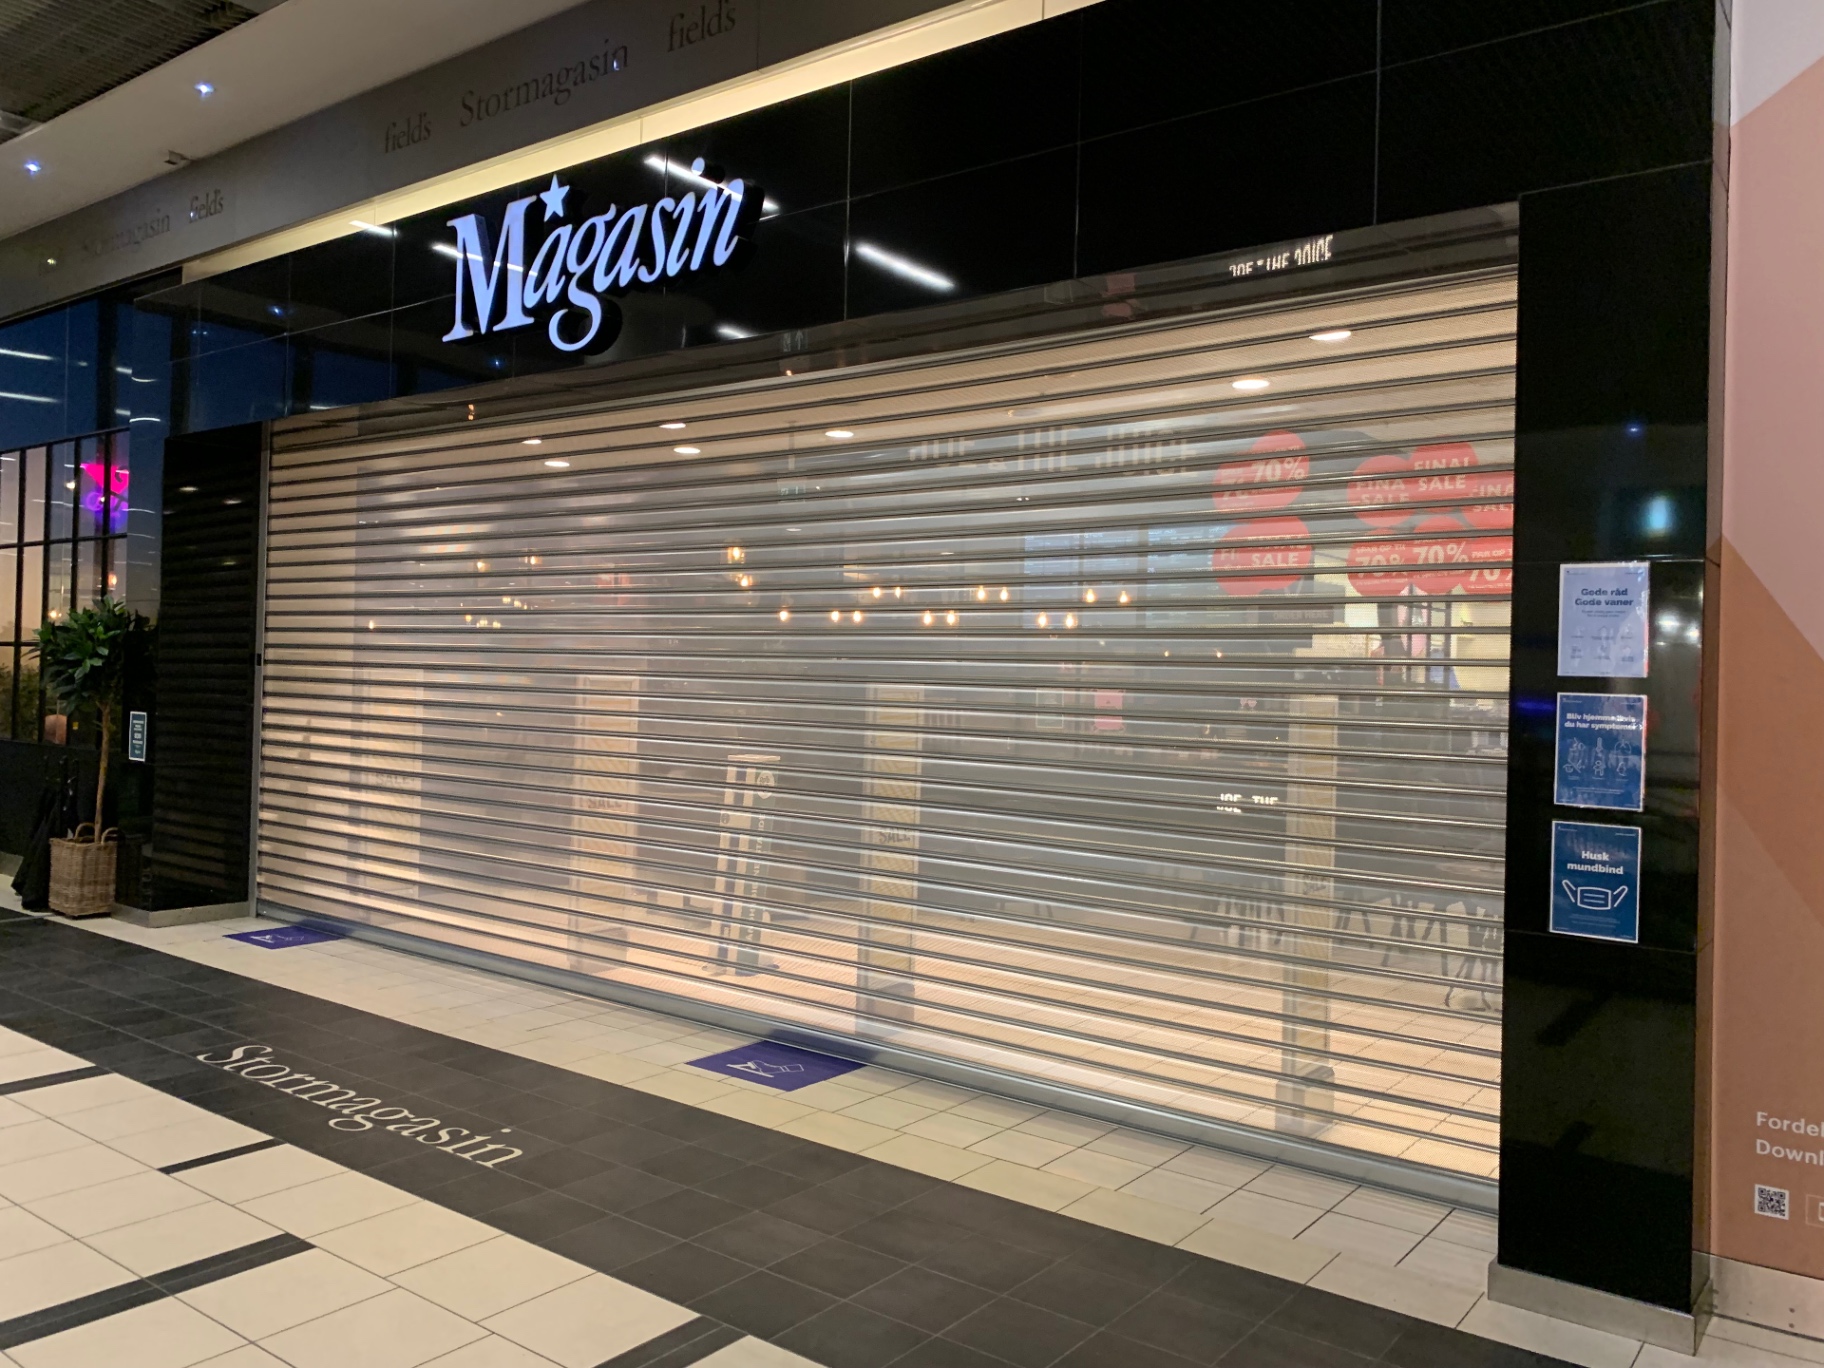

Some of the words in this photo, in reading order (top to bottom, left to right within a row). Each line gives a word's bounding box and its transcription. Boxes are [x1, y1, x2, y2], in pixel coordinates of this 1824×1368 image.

[459, 39, 629, 127] Stormagasin
[442, 157, 744, 351] Magasin
[1418, 475, 1466, 491] SALE
[1251, 552, 1300, 567] SALE
[1413, 541, 1469, 573] 70%
[1581, 588, 1608, 596] Gode
[1610, 587, 1628, 596] råd
[1574, 598, 1602, 606] Gode
[1581, 851, 1609, 861] Husk
[1567, 863, 1624, 875] mundbind
[196, 1045, 523, 1168] Stormagasin
